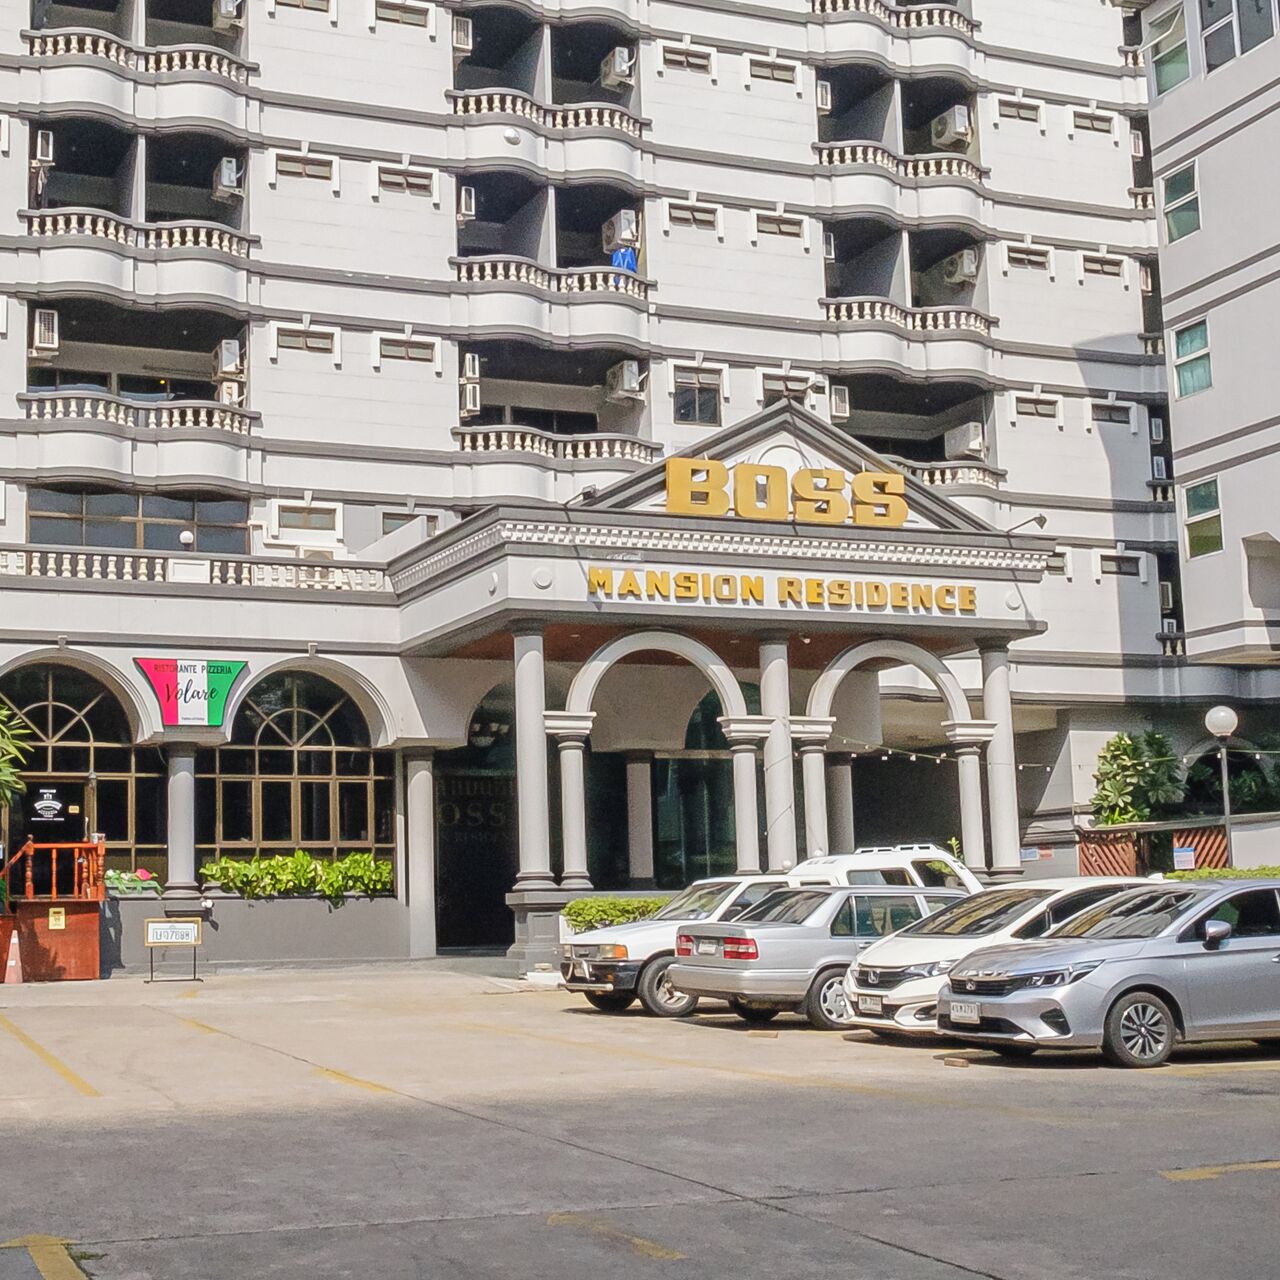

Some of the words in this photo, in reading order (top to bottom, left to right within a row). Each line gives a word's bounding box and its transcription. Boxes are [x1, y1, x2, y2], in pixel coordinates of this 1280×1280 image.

[666, 457, 909, 528] BOSS
[588, 565, 765, 606] MANSION
[777, 576, 977, 612] RESIDENCE
[153, 663, 197, 674] RISTORANTE
[201, 664, 232, 674] PIZZERIA
[165, 678, 219, 704] Volare
